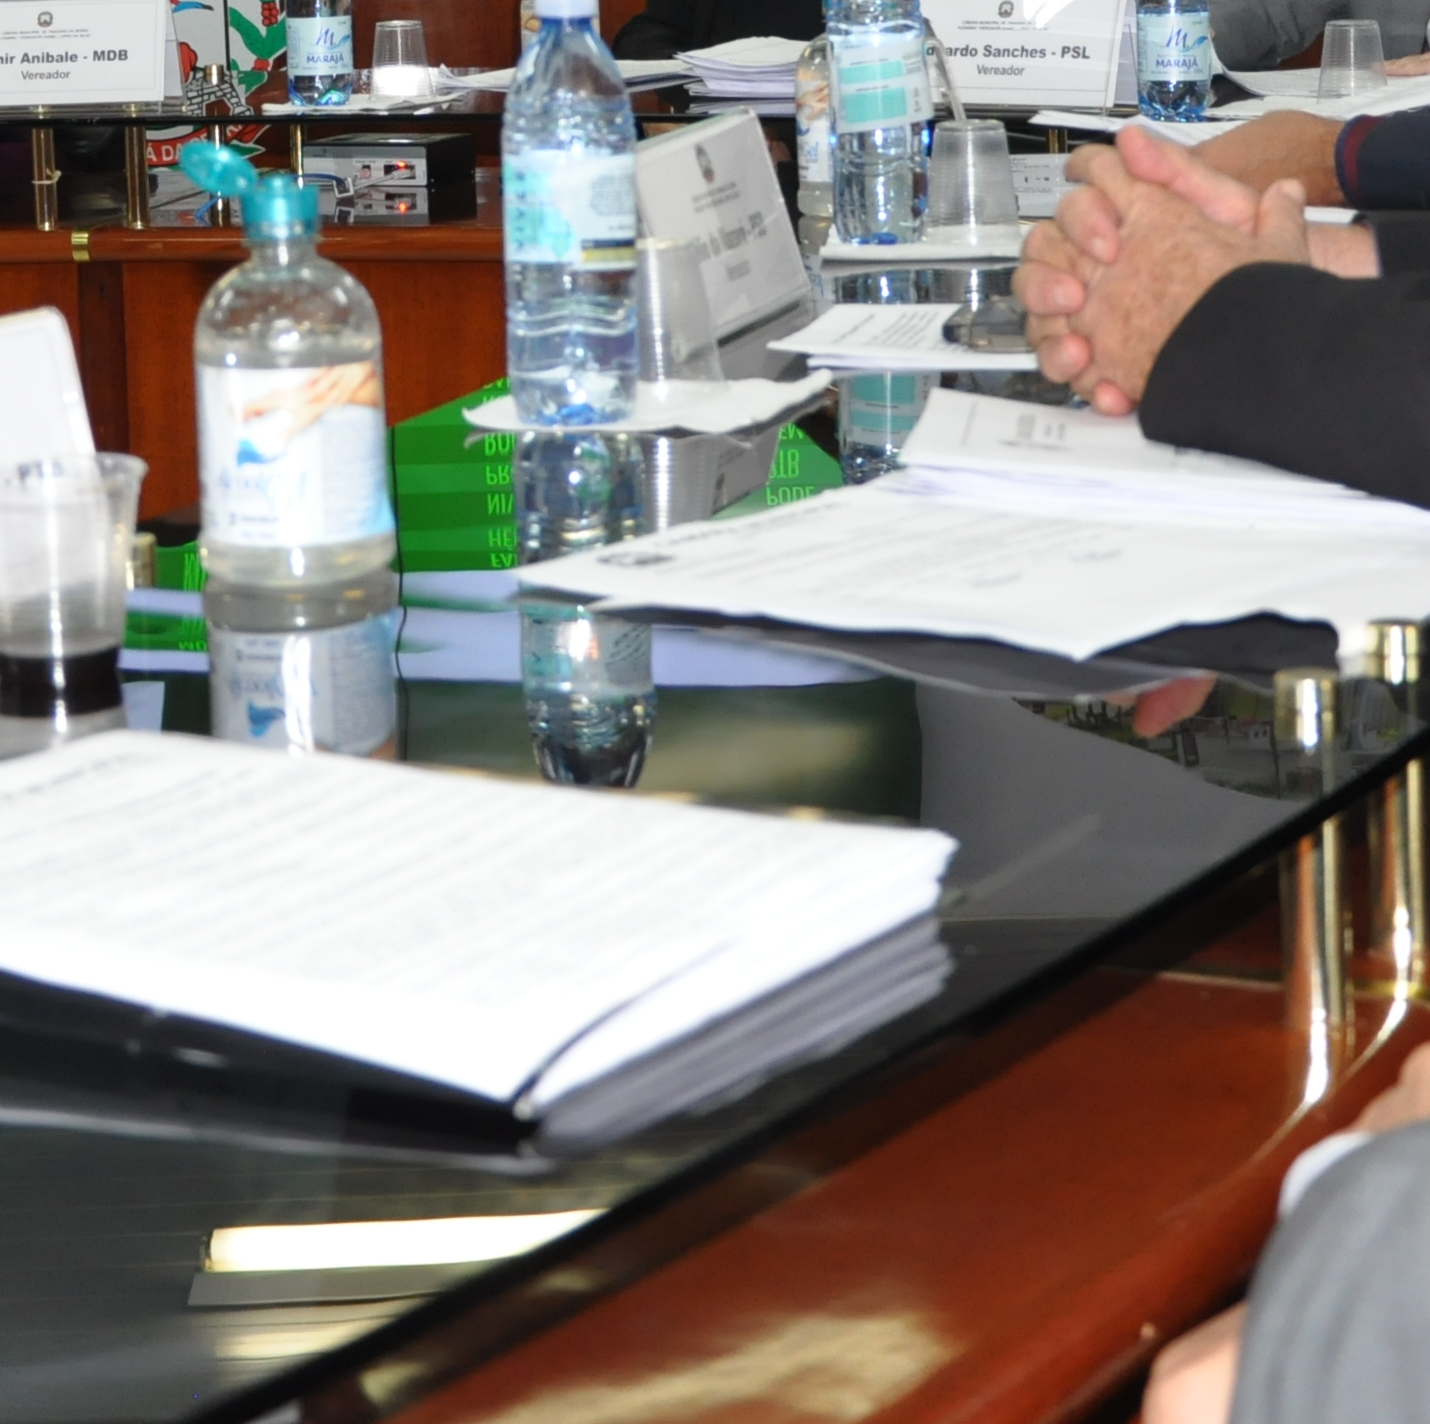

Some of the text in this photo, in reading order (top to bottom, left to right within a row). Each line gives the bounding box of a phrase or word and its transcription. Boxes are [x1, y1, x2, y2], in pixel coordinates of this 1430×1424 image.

[19, 50, 78, 65] Anibale
[92, 49, 129, 62] MDB
[983, 44, 1047, 59] Sanches
[1061, 45, 1091, 59] PSL
[306, 53, 344, 65] MARAJÁ
[1155, 57, 1198, 70] MARAJÁ
[20, 69, 70, 81] Vereador
[977, 64, 1026, 76] Vereador
